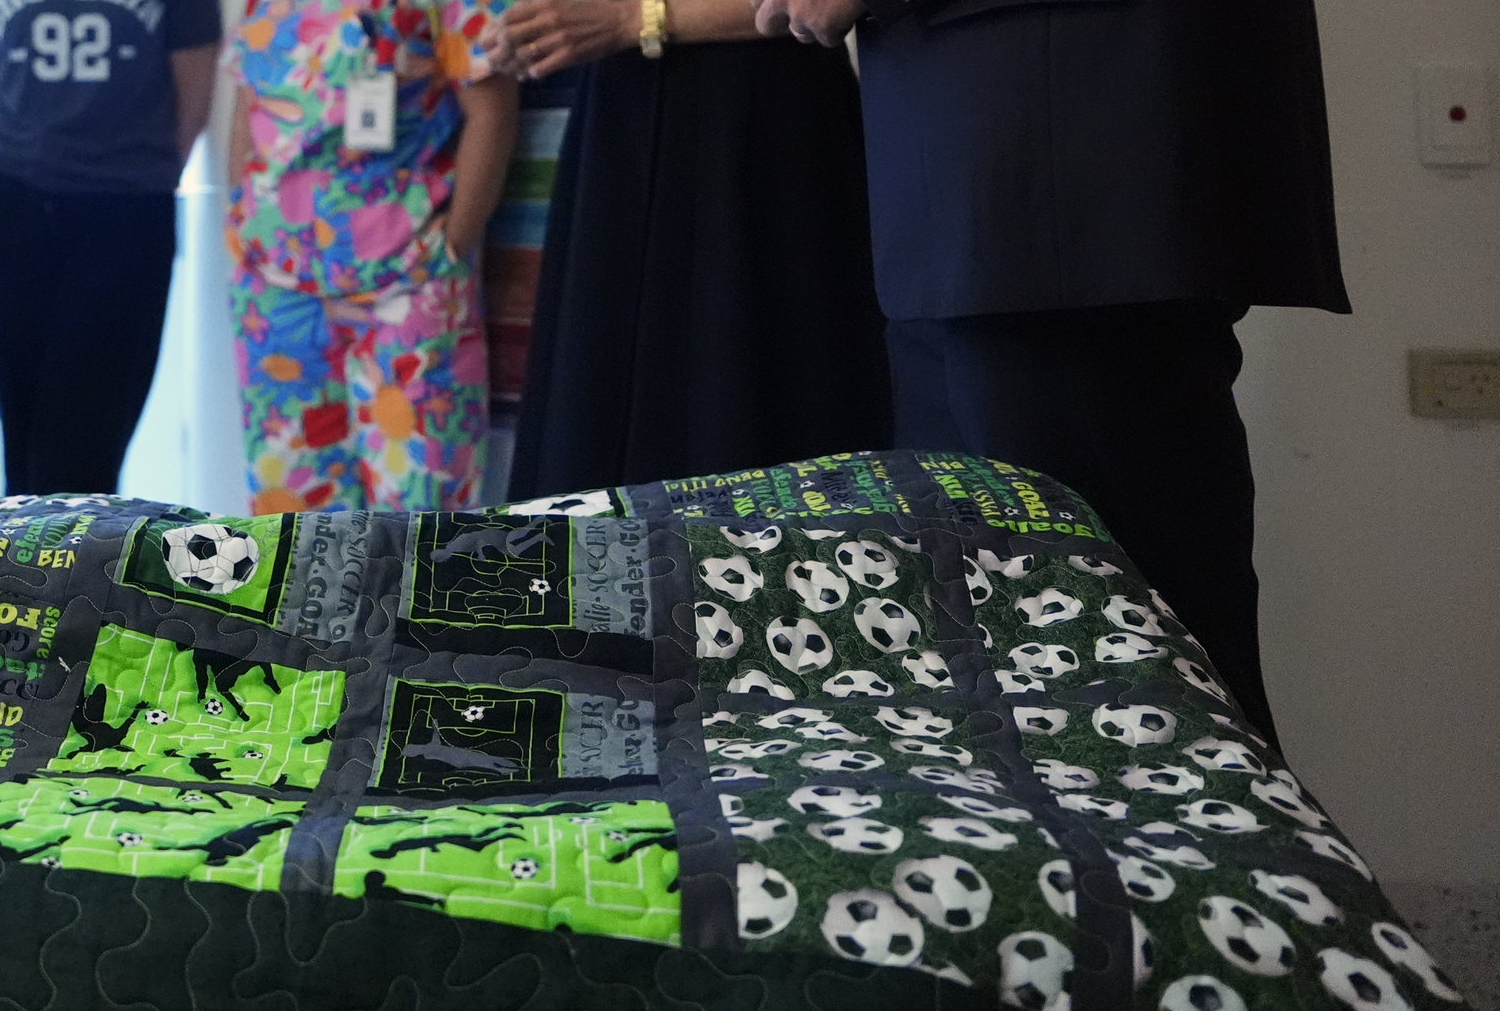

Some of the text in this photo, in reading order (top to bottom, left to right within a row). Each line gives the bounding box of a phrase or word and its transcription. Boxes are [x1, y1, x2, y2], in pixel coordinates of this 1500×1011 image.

[1011, 480, 1051, 520] GOAL
[986, 519, 1096, 539] goalie
[36, 605, 61, 660] score
